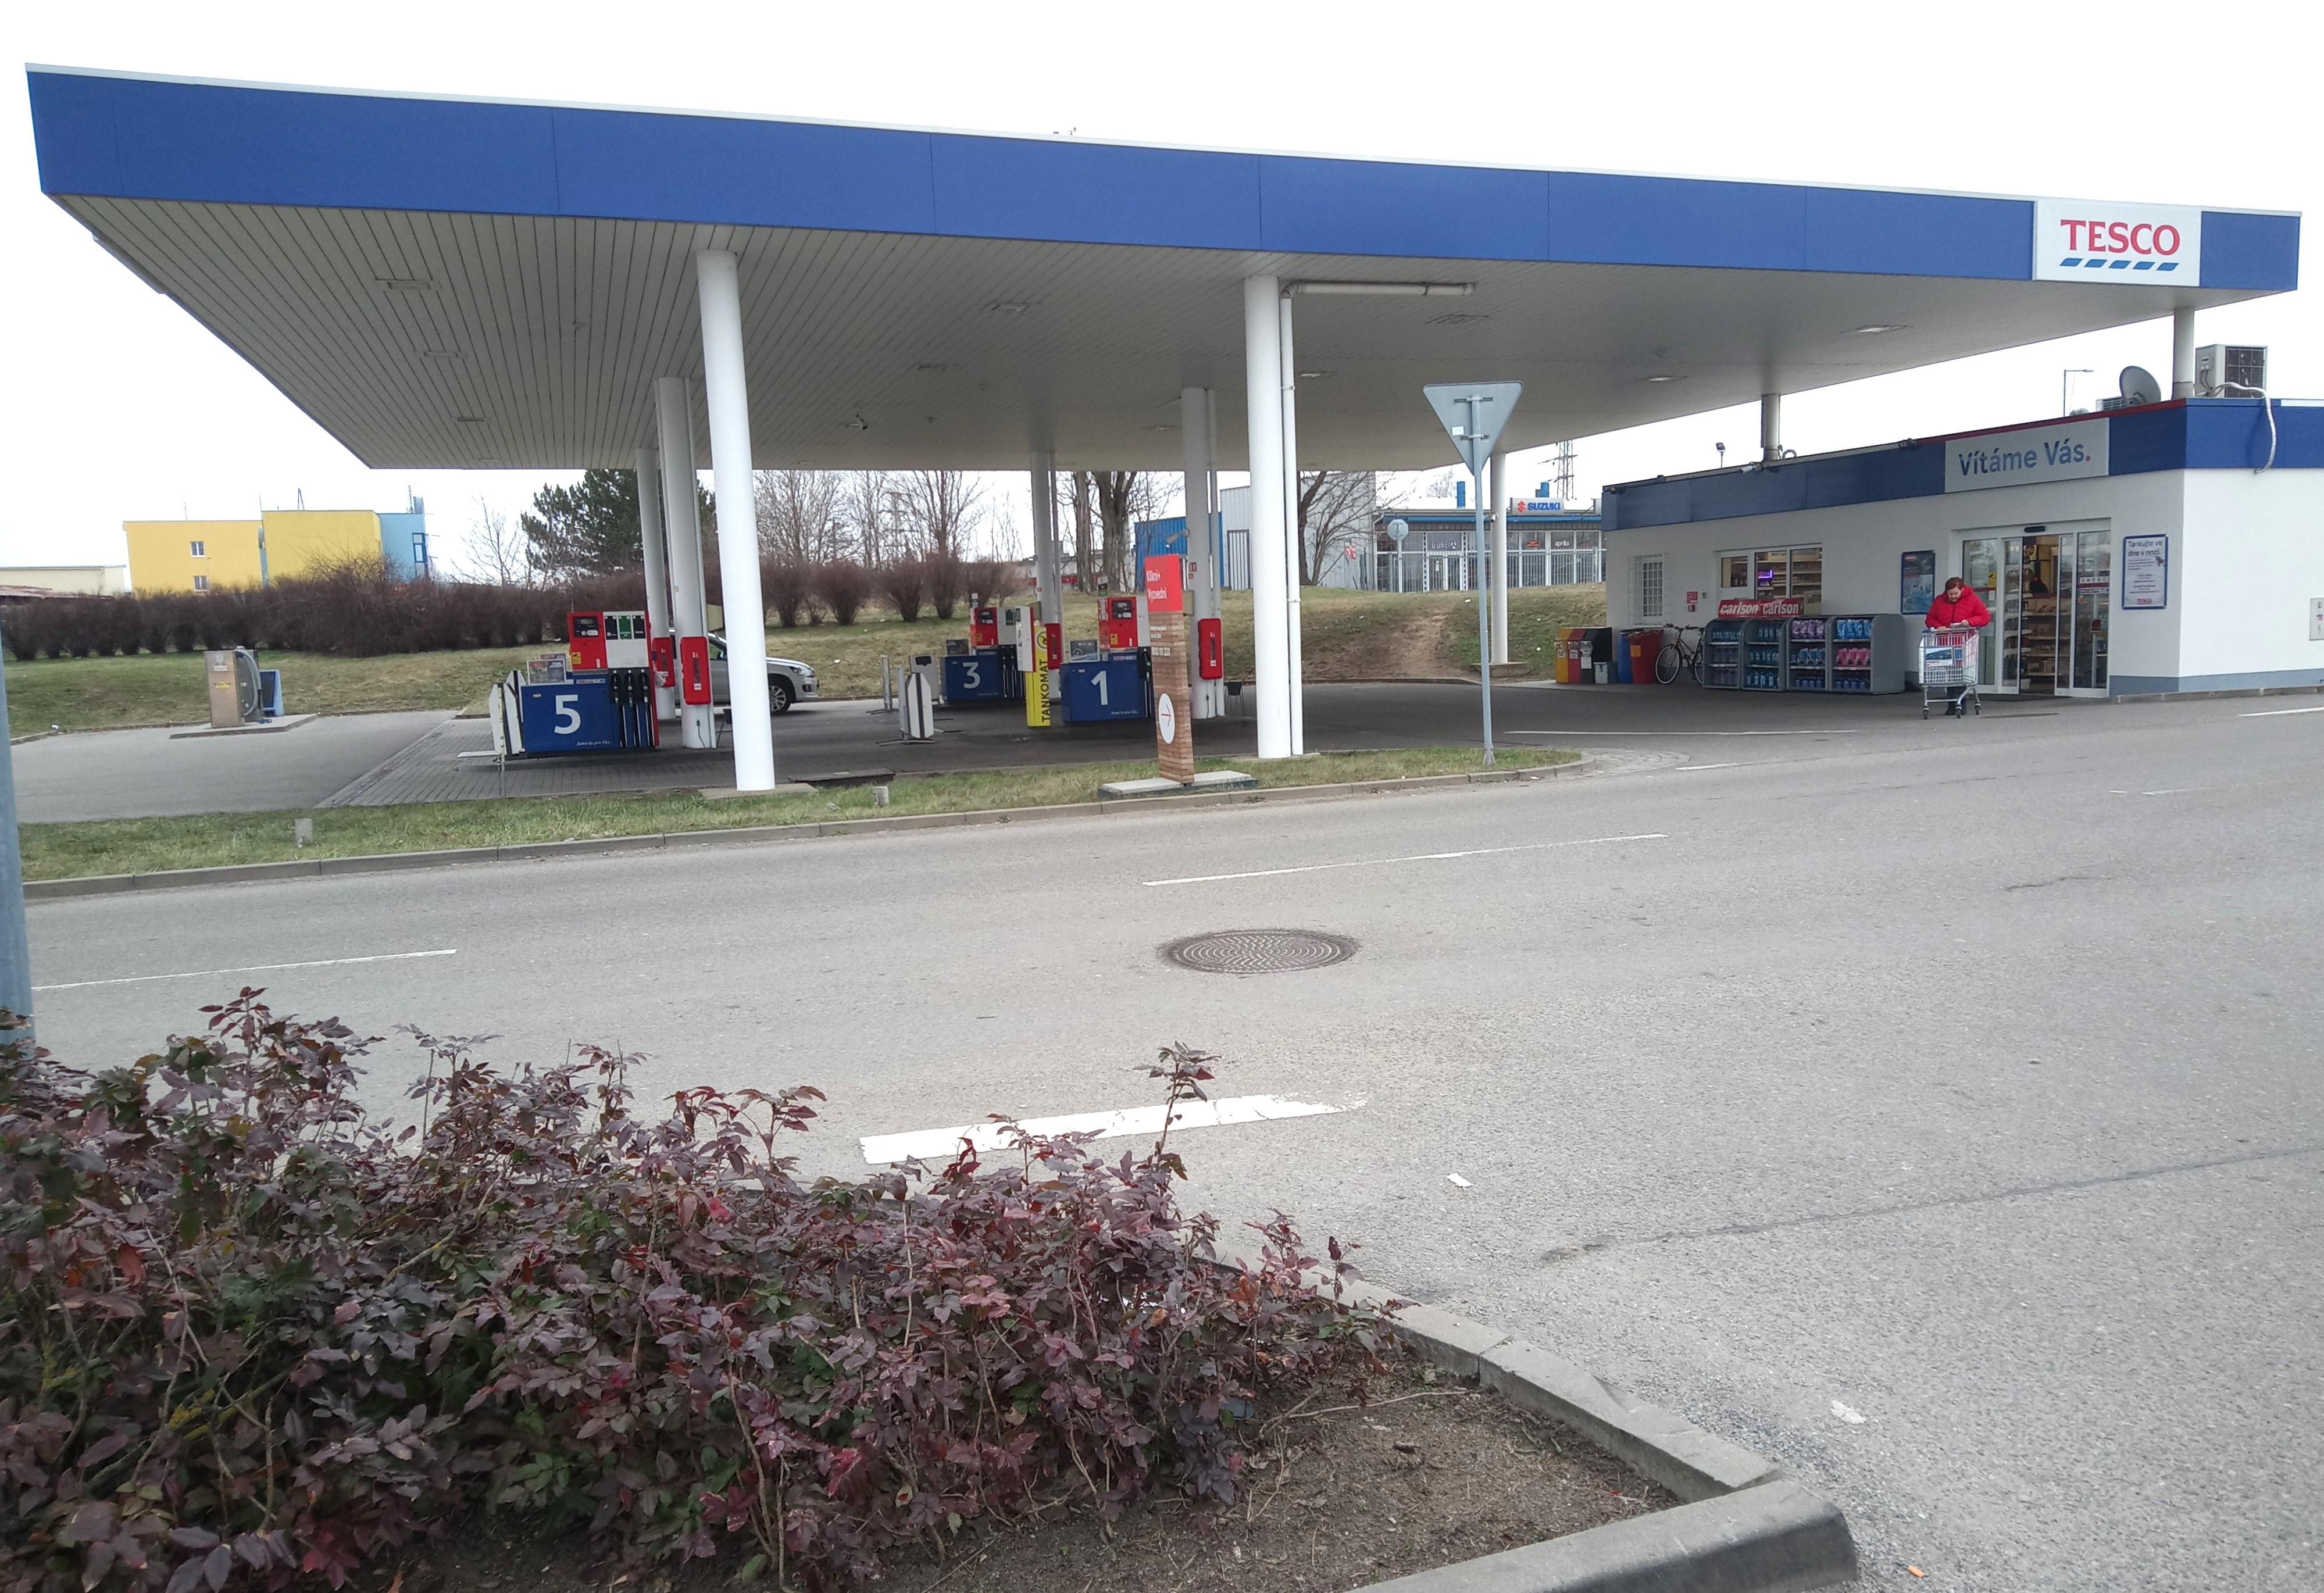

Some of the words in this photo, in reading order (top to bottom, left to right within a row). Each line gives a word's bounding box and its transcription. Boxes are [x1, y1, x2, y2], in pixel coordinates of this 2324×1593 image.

[2060, 219, 2180, 256] TESCO
[1958, 448, 2037, 476] Vítáme
[2044, 438, 2091, 466] Vás.
[1527, 502, 1561, 510] SUZUKI
[1554, 540, 1570, 548] aprilia
[1146, 569, 1161, 582] Klikni+
[1147, 587, 1168, 603] Vyzvedni
[1720, 601, 1759, 615] carlson
[1762, 601, 1799, 615] carlson
[963, 662, 981, 689] 3
[1039, 659, 1051, 723] TANKOMAT
[1091, 670, 1108, 706] 1
[554, 694, 581, 735] 5
